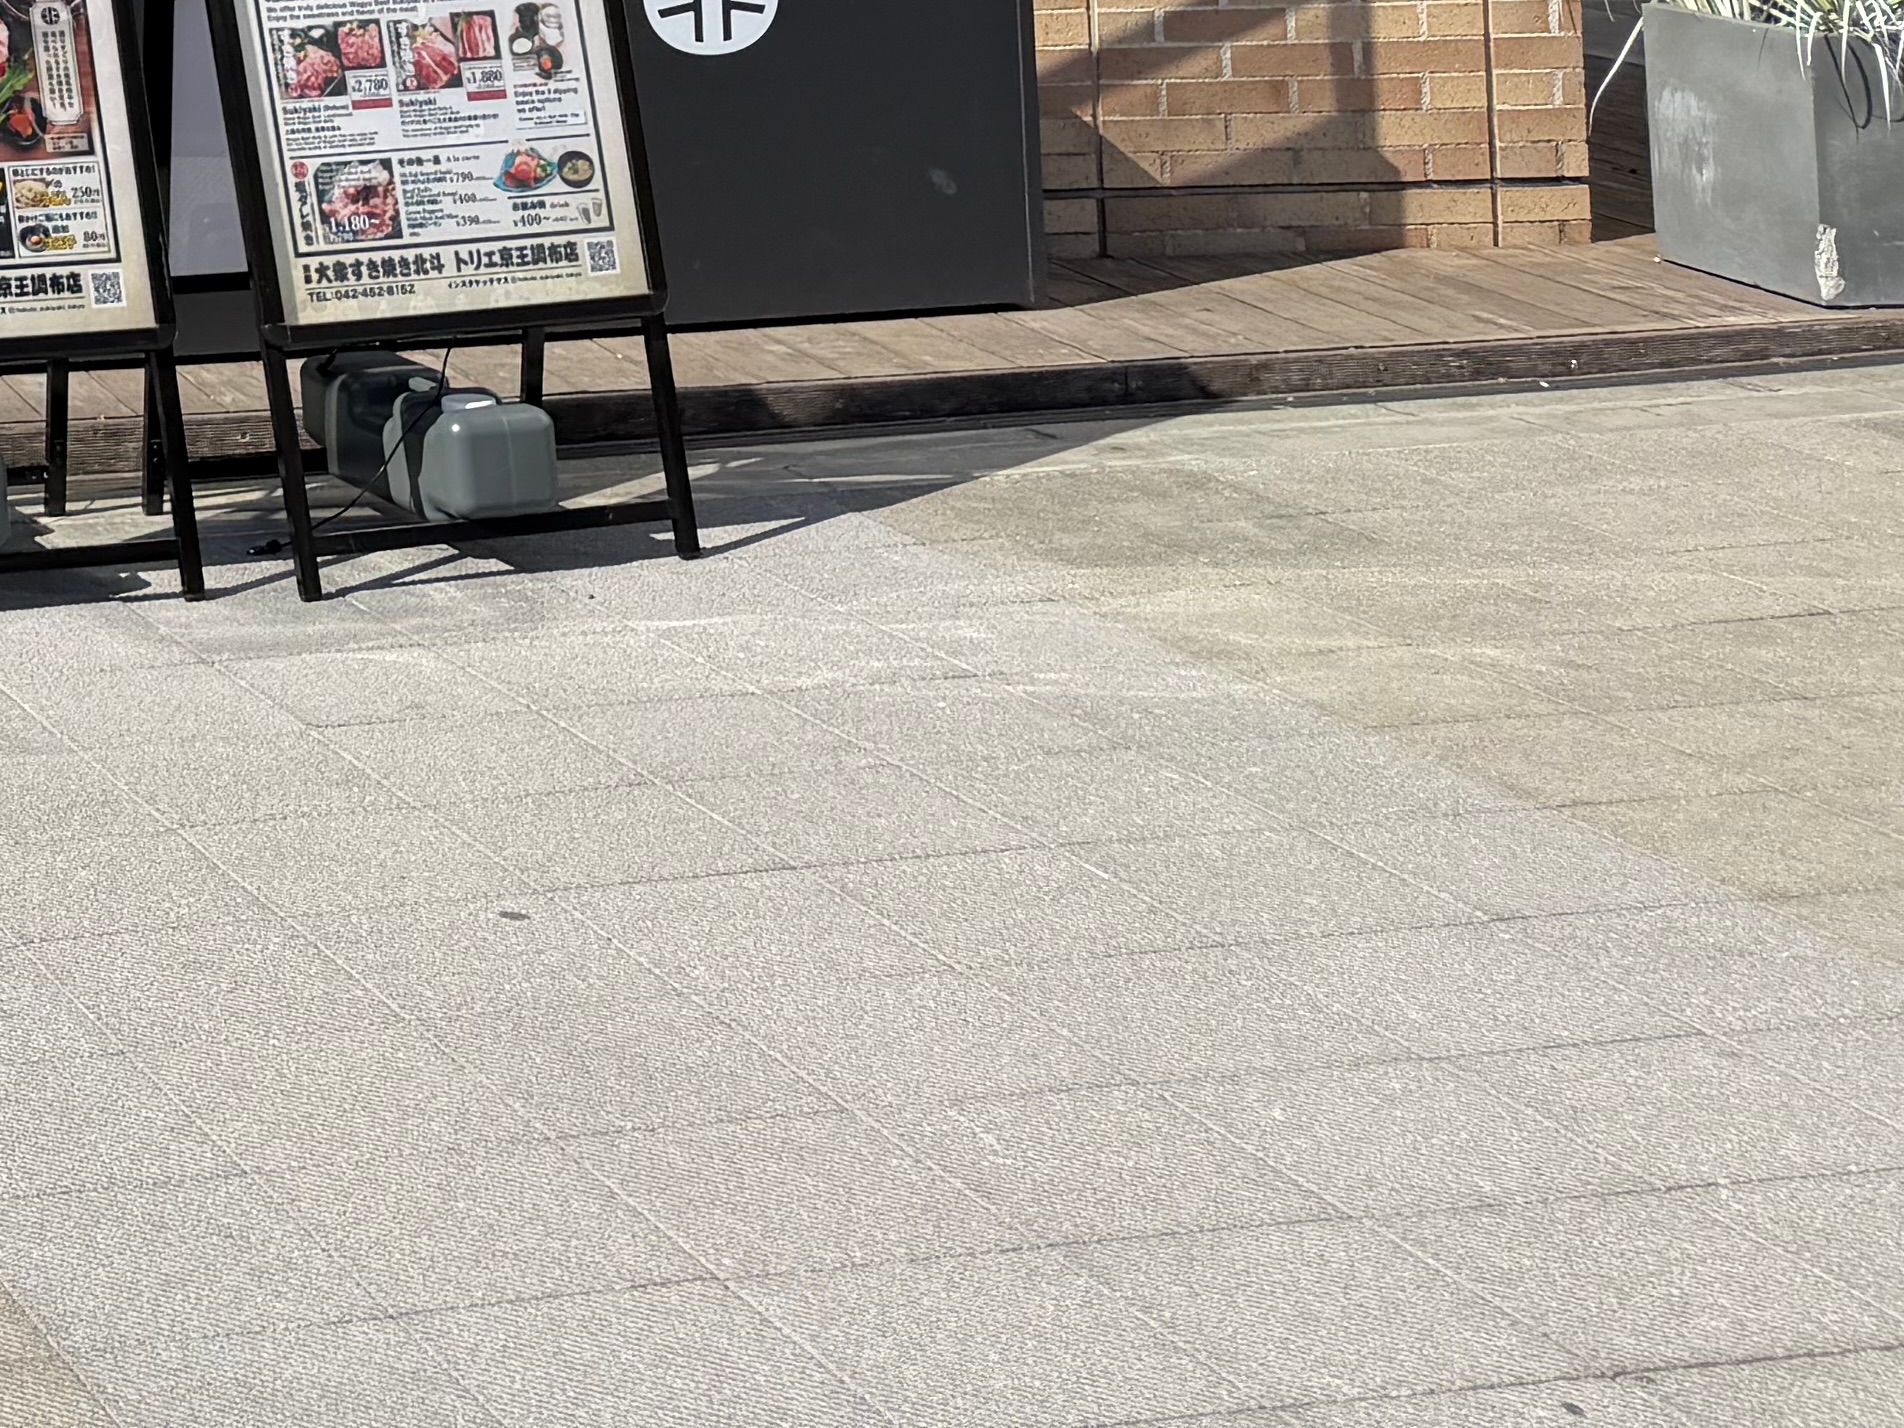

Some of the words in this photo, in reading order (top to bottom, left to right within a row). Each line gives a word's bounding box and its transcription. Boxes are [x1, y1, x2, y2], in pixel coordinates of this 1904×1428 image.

[316, 252, 446, 284] 大衆すき焼き北斗
[453, 240, 580, 272] トリエ京王調布店
